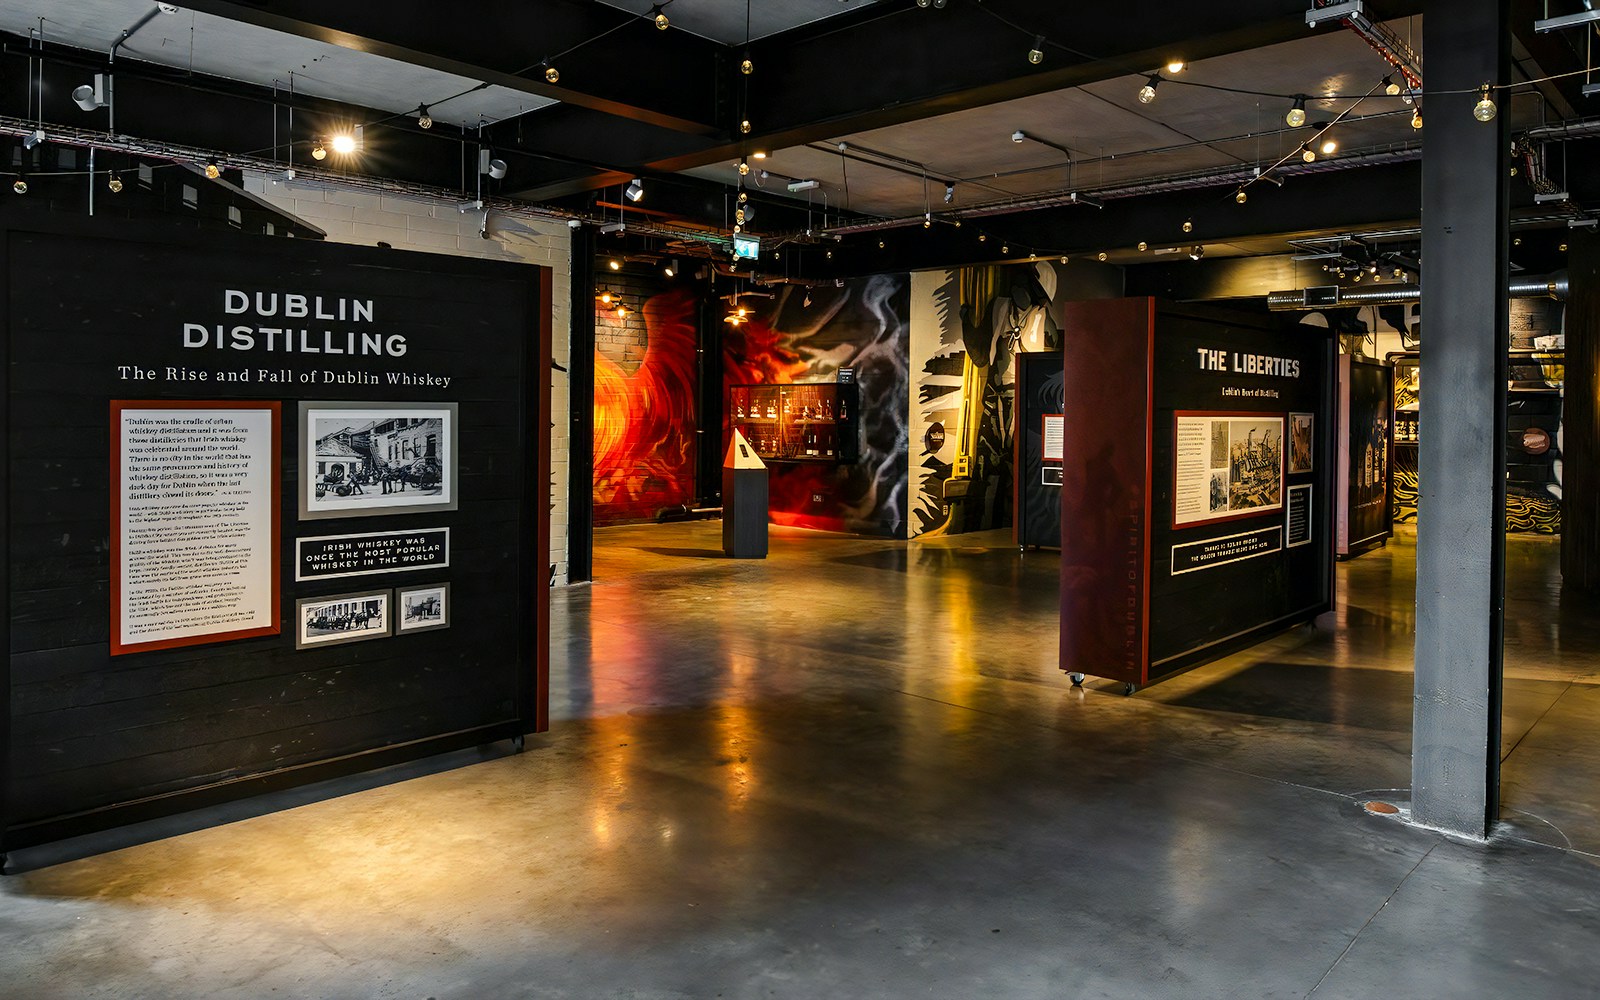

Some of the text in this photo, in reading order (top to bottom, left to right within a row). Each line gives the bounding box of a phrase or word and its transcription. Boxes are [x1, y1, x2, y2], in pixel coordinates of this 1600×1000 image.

[225, 289, 373, 322] DUBLIN
[183, 323, 407, 357] DISTILLING
[1198, 348, 1300, 378] THE LIBERTIES
[118, 366, 451, 388] The Rise and Fall of Dublin Whiskey
[306, 553, 334, 562] ONCE
[365, 549, 391, 557] MOST
[397, 545, 440, 554] POPULAR
[358, 539, 401, 549] WHISKEY
[312, 560, 359, 570] WHISKEY
